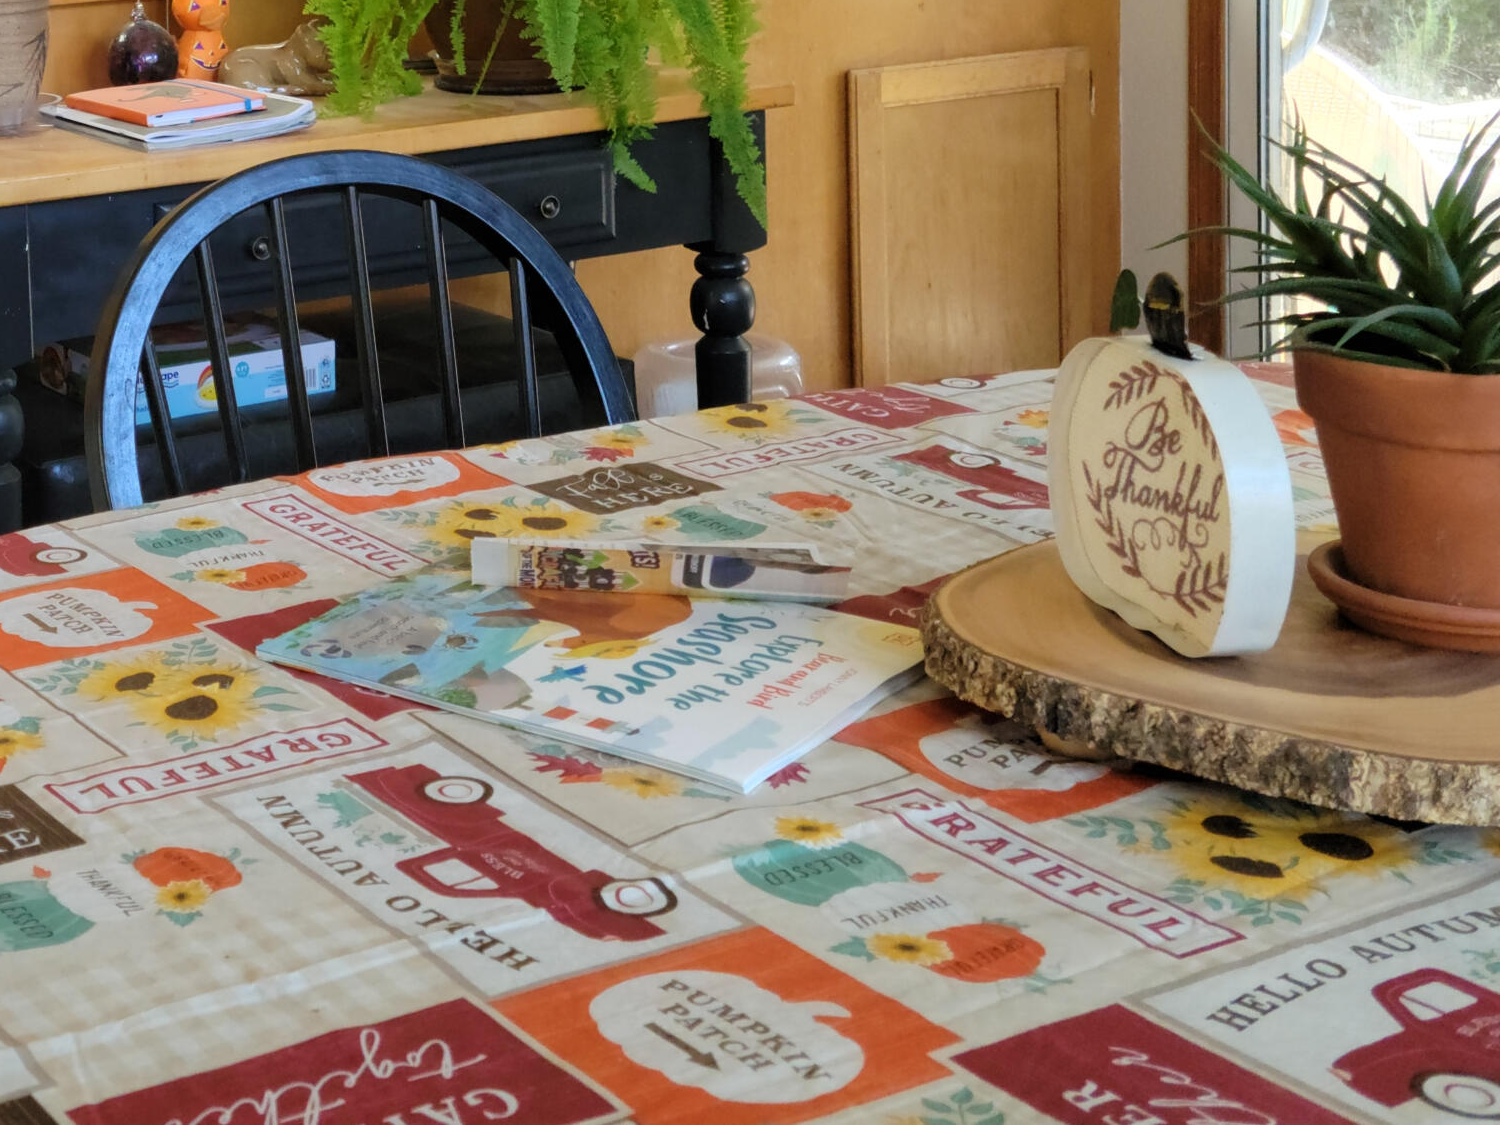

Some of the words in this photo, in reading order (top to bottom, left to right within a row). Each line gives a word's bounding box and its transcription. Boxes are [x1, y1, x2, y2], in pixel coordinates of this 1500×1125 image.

[1125, 397, 1183, 457] Be
[320, 457, 435, 483] PUMPKIN
[700, 432, 879, 471] GRATEFUL
[351, 469, 426, 485] PATCH
[591, 482, 694, 509] HERE
[834, 462, 959, 509] AUTUMN
[1104, 443, 1225, 539] Thankful
[152, 529, 225, 549] BLESSED
[186, 551, 265, 568] THANKFUL
[268, 503, 409, 571] GRATEFUL
[37, 603, 94, 635] PATCH
[45, 592, 125, 638] PUMPKIN
[582, 612, 778, 705] Seashore
[714, 634, 825, 686] Explore
[781, 665, 809, 690] and
[806, 652, 848, 677] Bear
[666, 683, 730, 711] the
[746, 683, 791, 710] Bird
[79, 733, 353, 799] GRATEFUL
[256, 794, 389, 887] AUTUMN
[75, 867, 146, 917] THANKFUL
[763, 851, 864, 887] BLESSED
[385, 895, 542, 972] HELLO
[841, 894, 953, 930] THANKFUL
[1205, 958, 1348, 1031] HELLO
[1350, 905, 1500, 964] AUTUM
[656, 1002, 776, 1072] PATCH
[657, 979, 833, 1081] PUMPKIN
